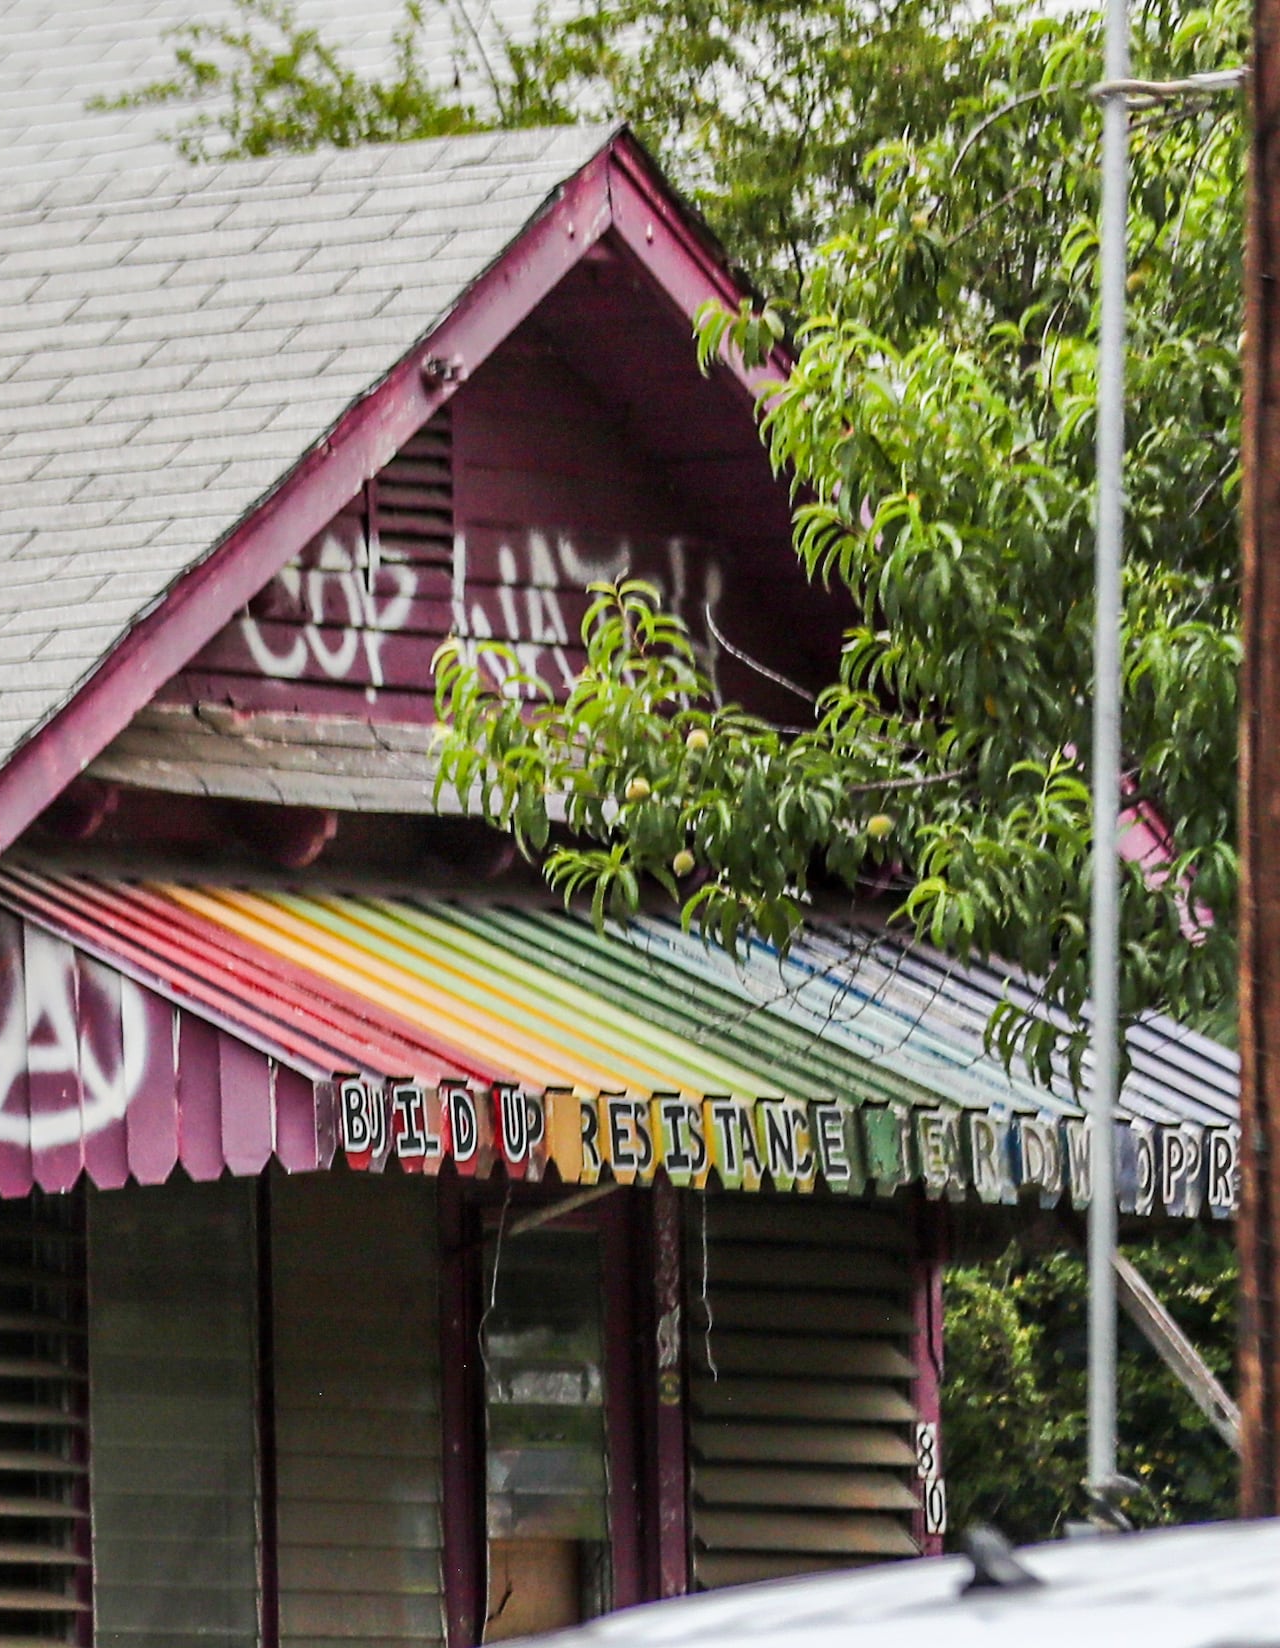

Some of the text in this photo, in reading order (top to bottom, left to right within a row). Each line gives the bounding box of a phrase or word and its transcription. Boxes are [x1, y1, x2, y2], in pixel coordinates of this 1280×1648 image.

[242, 535, 418, 703] COP
[341, 1079, 477, 1161] BUILD
[500, 1088, 544, 1164] UP
[581, 1098, 849, 1181] RESISTANCE
[1136, 1130, 1239, 1208] OPPR
